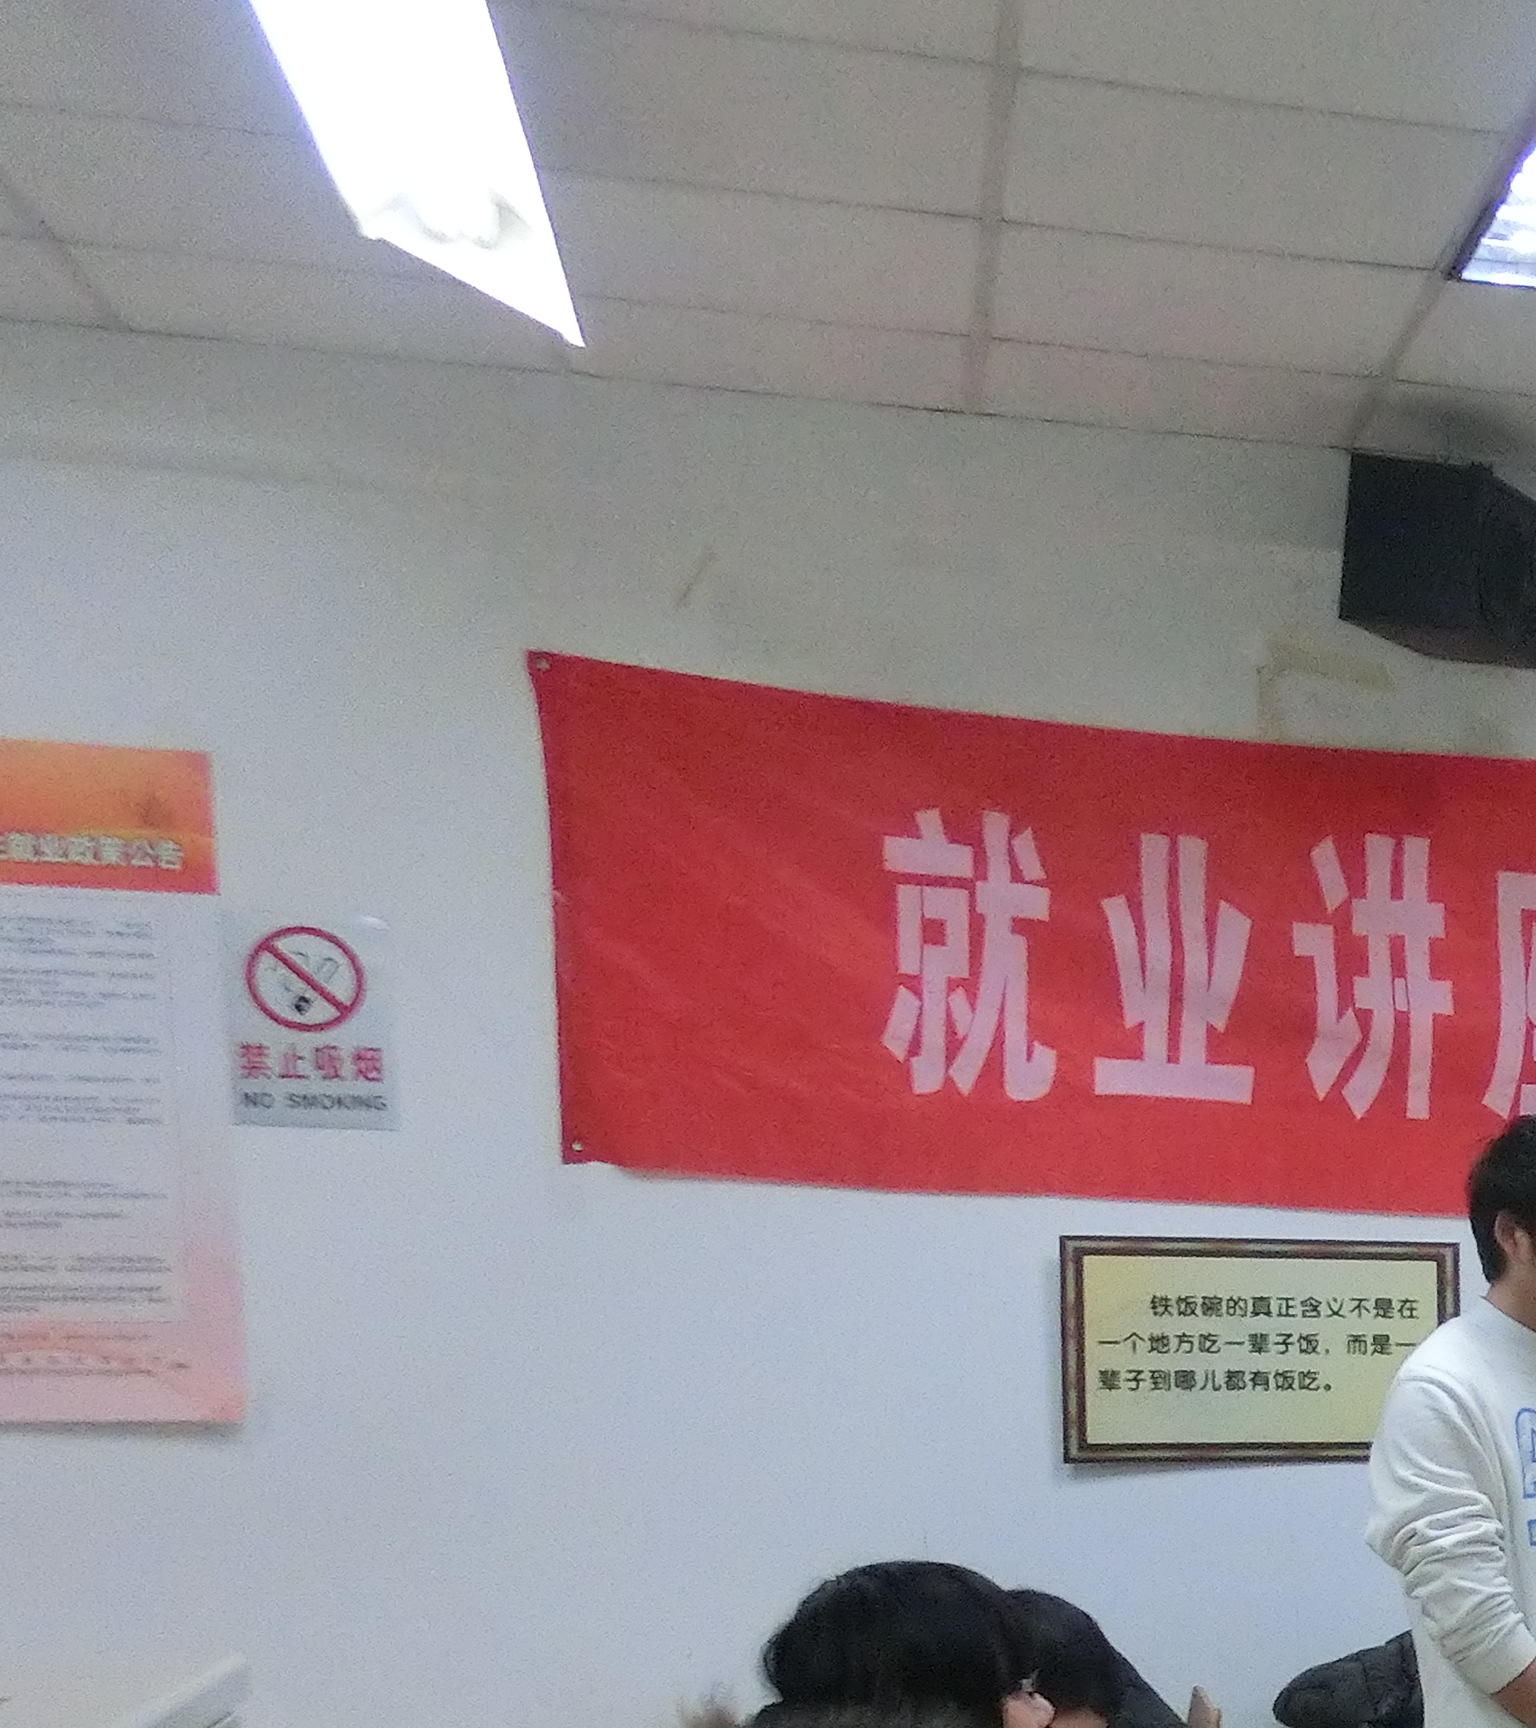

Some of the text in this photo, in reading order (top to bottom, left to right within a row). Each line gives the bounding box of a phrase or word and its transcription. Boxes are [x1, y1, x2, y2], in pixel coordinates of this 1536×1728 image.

[239, 1041, 384, 1083] 禁止吸烟
[242, 1091, 388, 1112] NO SMOKING
[1149, 1294, 1420, 1320] 铁饭碗的真正含义不是在
